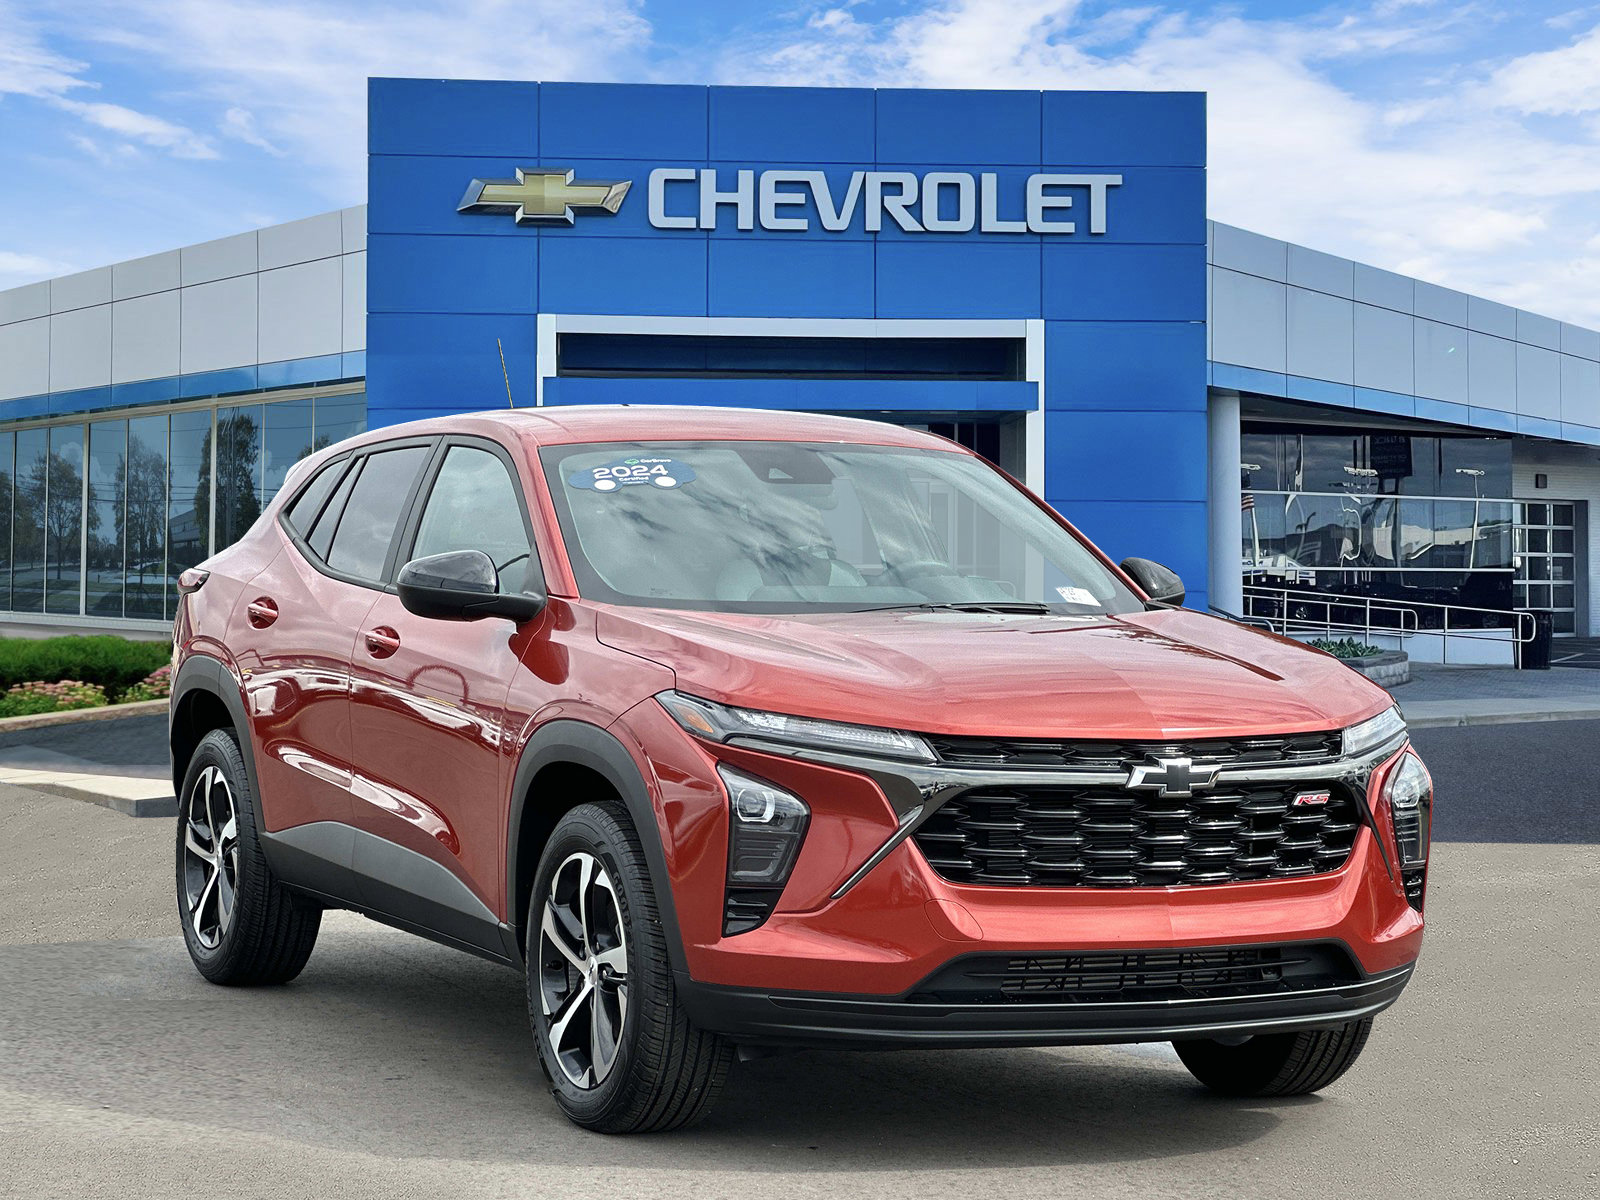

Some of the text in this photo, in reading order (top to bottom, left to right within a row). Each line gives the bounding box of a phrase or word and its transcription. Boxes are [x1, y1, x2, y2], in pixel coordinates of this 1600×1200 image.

[648, 168, 1123, 234] CHEVROLET
[592, 464, 669, 479] 2024
[1294, 793, 1331, 806] RS
